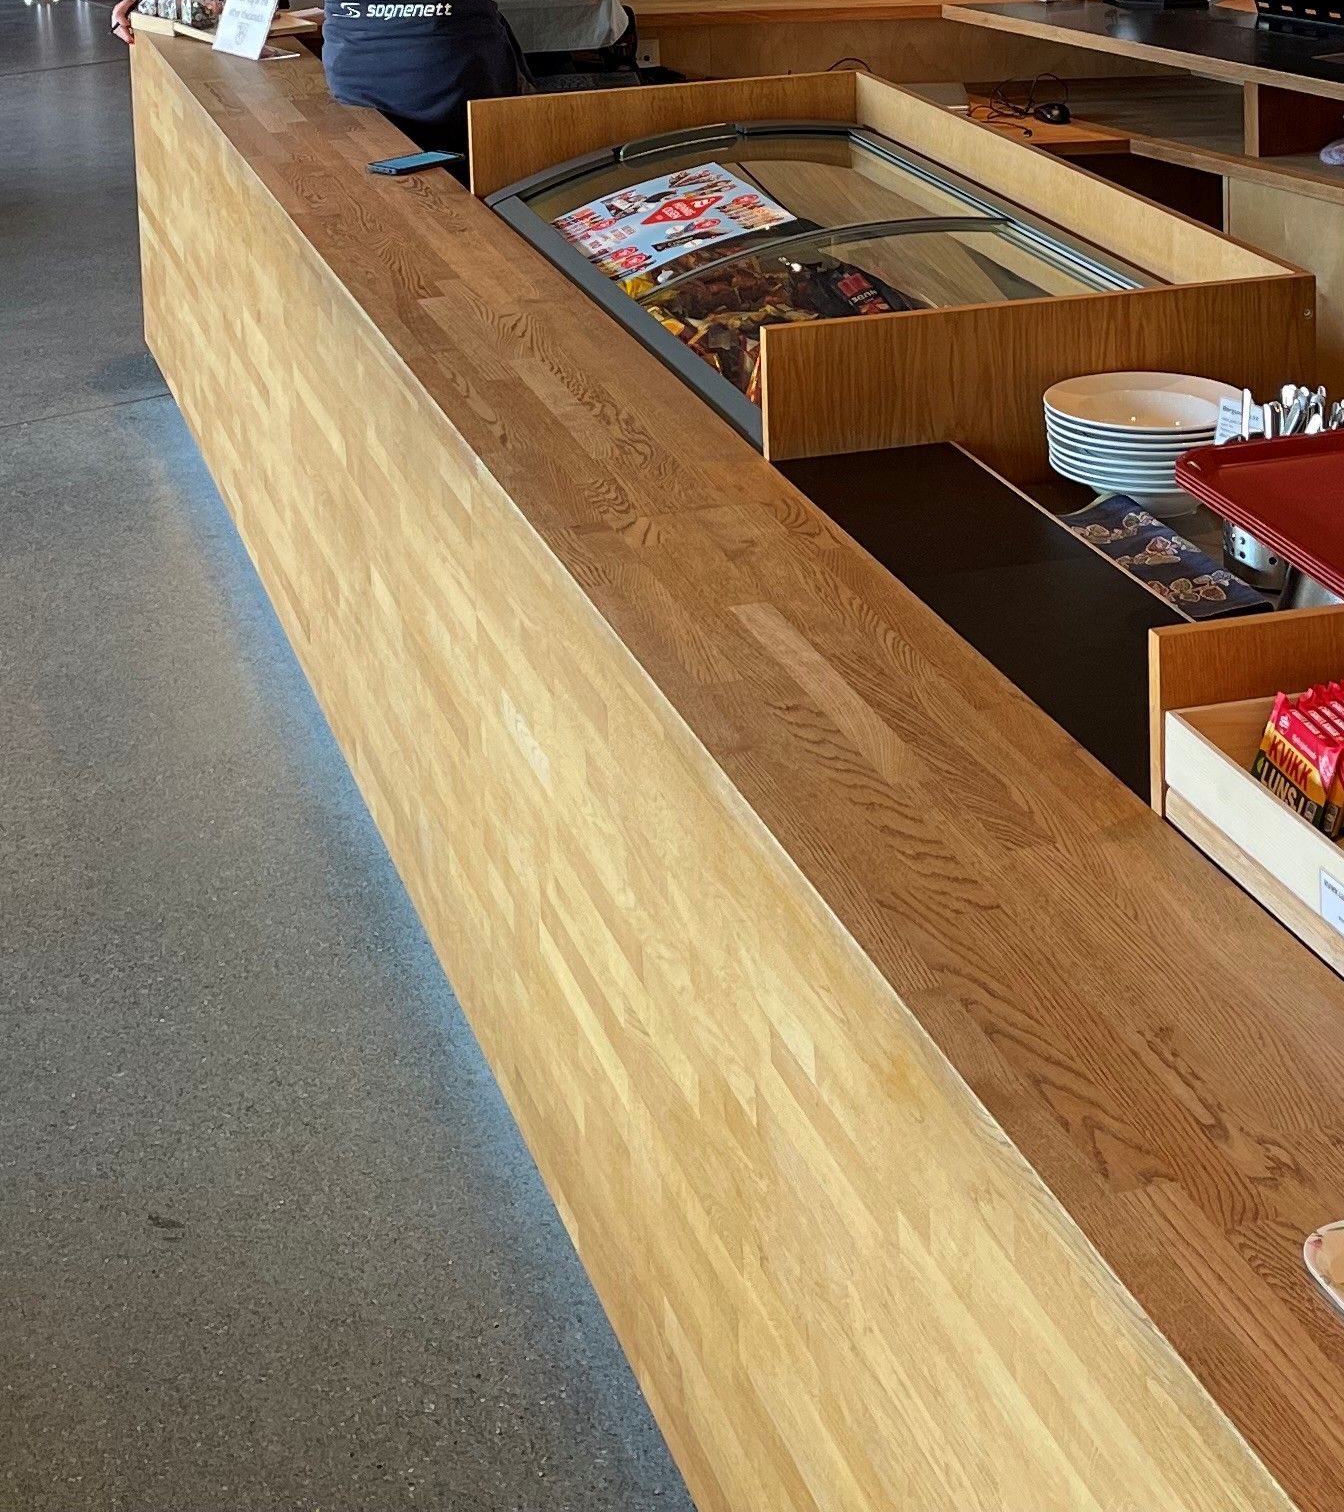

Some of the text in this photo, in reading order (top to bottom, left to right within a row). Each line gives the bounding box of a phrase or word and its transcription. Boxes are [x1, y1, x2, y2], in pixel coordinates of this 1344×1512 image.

[366, 2, 452, 21] sognenett
[1268, 734, 1314, 790] KVIKK
[1260, 760, 1307, 822] LUNSJ
